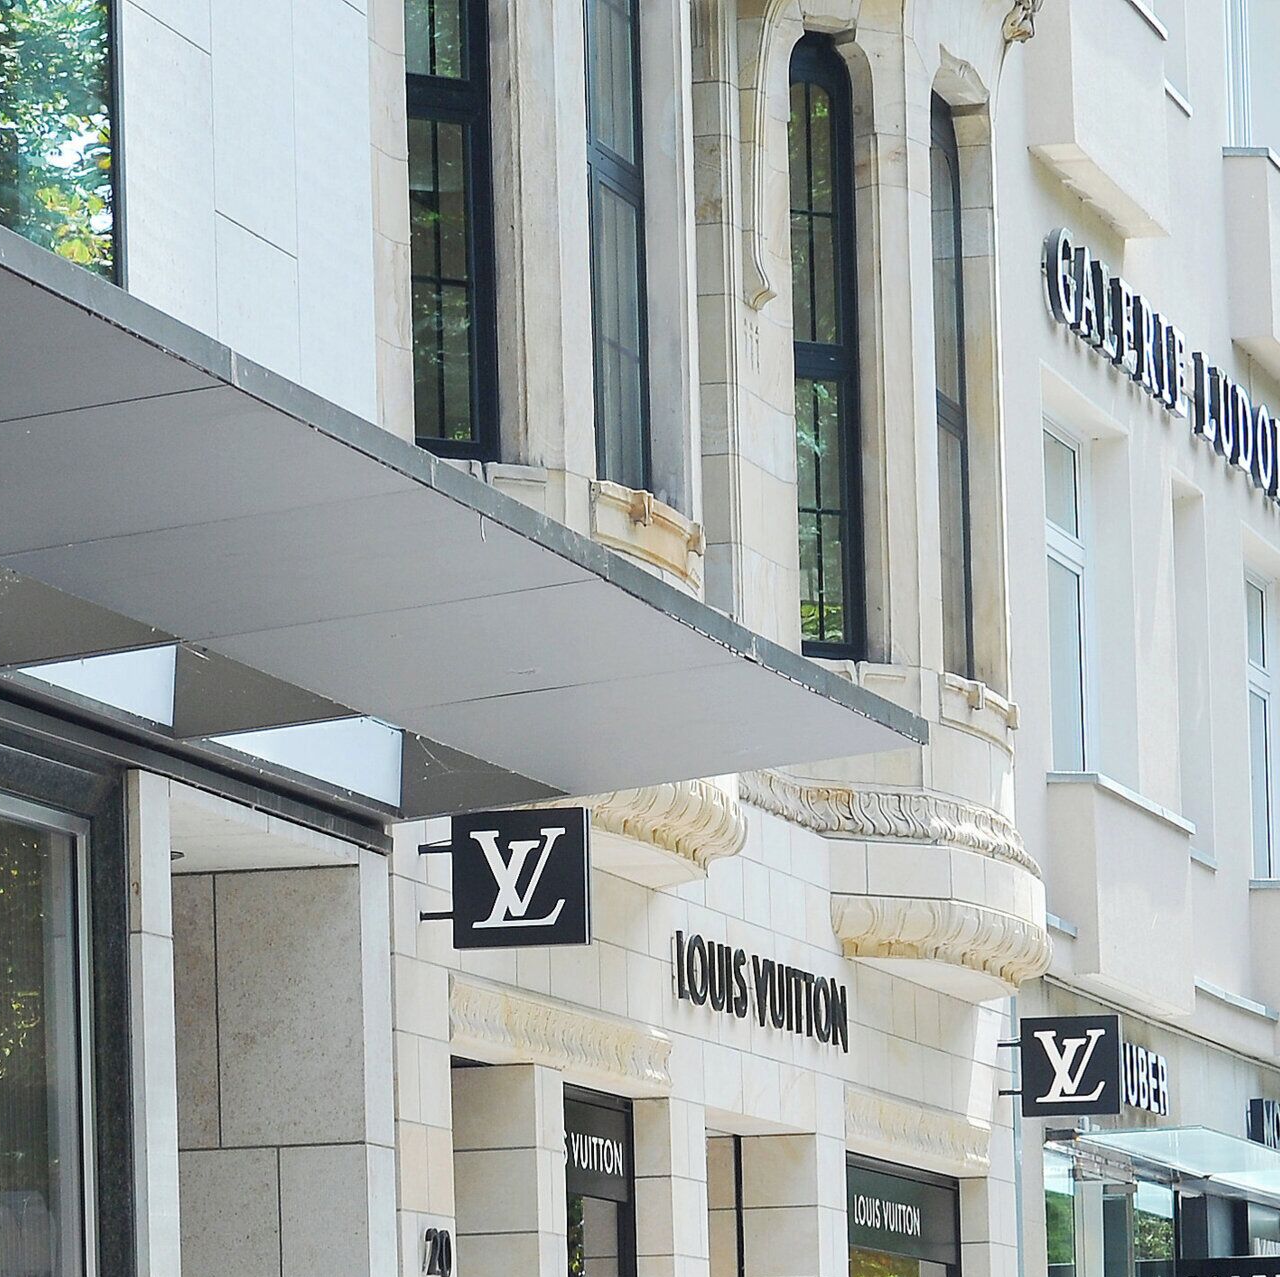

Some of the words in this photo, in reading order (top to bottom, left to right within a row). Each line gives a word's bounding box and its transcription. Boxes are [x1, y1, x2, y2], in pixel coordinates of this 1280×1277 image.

[1045, 227, 1188, 419] GALERIE
[675, 930, 748, 1019] LOUIS
[751, 954, 849, 1053] VUITTON
[570, 1131, 624, 1177] VUITTON
[854, 1194, 881, 1229] LOUIS
[881, 1200, 921, 1237] VUITTON
